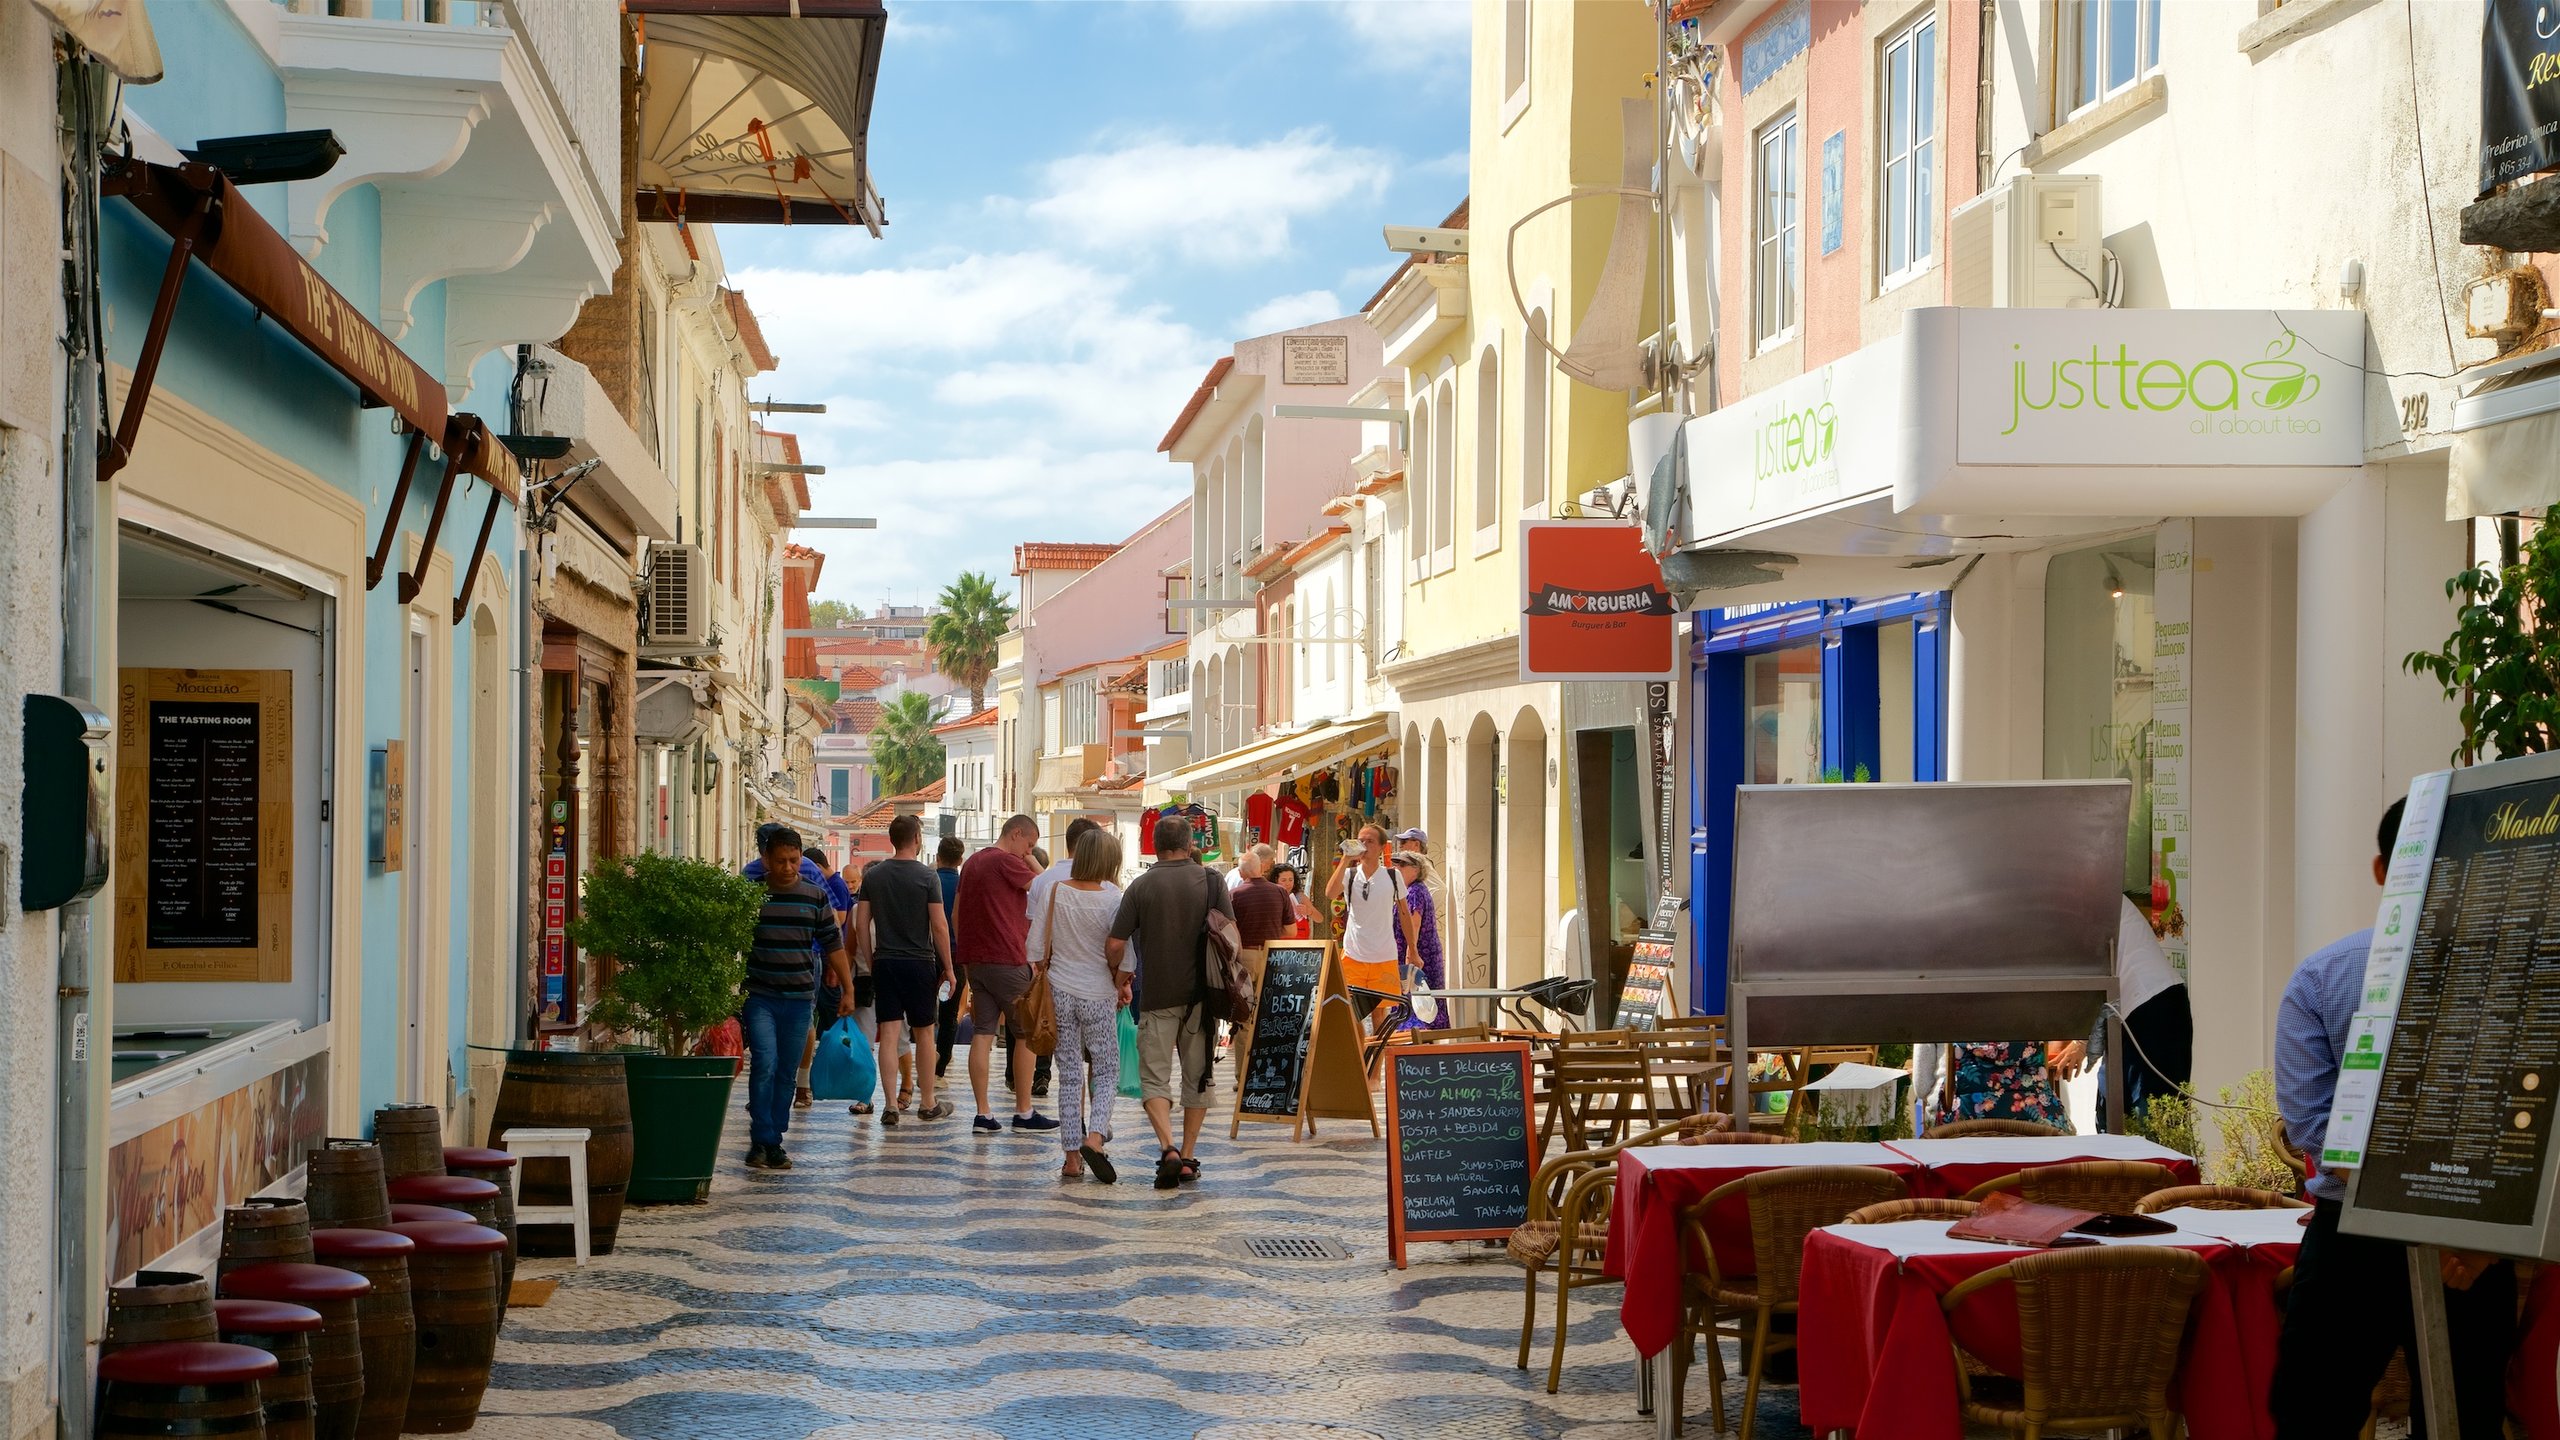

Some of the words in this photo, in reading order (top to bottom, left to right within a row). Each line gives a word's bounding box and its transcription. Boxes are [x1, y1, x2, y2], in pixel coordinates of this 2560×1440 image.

[2485, 135, 2528, 162] Frederico
[2499, 160, 2515, 176] 865
[2516, 155, 2532, 173] 334
[298, 259, 333, 343] THE
[330, 291, 387, 387] TASTING
[384, 342, 419, 413] ROOM
[2001, 344, 2239, 436] justtea
[2402, 392, 2429, 432] 292
[2189, 414, 2213, 434] all
[2219, 414, 2283, 434] about
[2287, 416, 2321, 434] tea
[1571, 620, 1604, 630] Burguer
[1605, 621, 1612, 629] &
[1613, 620, 1627, 628] Bar
[2155, 620, 2190, 642] Pequenos
[2154, 640, 2186, 661] Almoços
[2155, 665, 2181, 685] English
[2154, 684, 2188, 704] Breakfast
[120, 684, 136, 748] ESPORÃO
[158, 716, 178, 724] THE
[180, 716, 221, 725] TASTING
[222, 717, 252, 725] ROOM
[277, 699, 286, 745] QUINTA
[2154, 720, 2181, 739] Menus
[1653, 717, 1662, 788] SAPATARIAS
[2154, 742, 2184, 764] Almoço
[2154, 768, 2177, 787] Lunch
[2154, 788, 2179, 806] Menus
[1289, 814, 1296, 831] 7
[2153, 812, 2167, 831] chá
[2173, 814, 2189, 831] TEA
[2484, 794, 2560, 843] Masala
[2160, 837, 2177, 922] 5
[1272, 973, 1293, 987] HOME
[1303, 973, 1317, 983] THE
[1271, 994, 1305, 1014] BEST
[1398, 1058, 1432, 1076] PROVE
[1439, 1061, 1448, 1075] E
[1400, 1089, 1436, 1101] MENU
[1439, 1088, 1482, 1102] ALMOÇO
[1400, 1109, 1424, 1120] SOPA
[1400, 1125, 1437, 1137] TOSTA
[1454, 1123, 1498, 1133] BEBIDA
[1403, 1150, 1452, 1162] WAFFLES
[1459, 1160, 1493, 1171] SUMOS
[1494, 1159, 1525, 1171] DETOX
[1424, 1174, 1443, 1183] TEA
[1446, 1172, 1490, 1183] NATURAL
[1462, 1184, 1521, 1197] SANGRIA
[1403, 1196, 1456, 1209] PASTELARIA
[1474, 1205, 1528, 1219] TAKE-AWAY
[1406, 1209, 1459, 1220] TRADICIONAL
